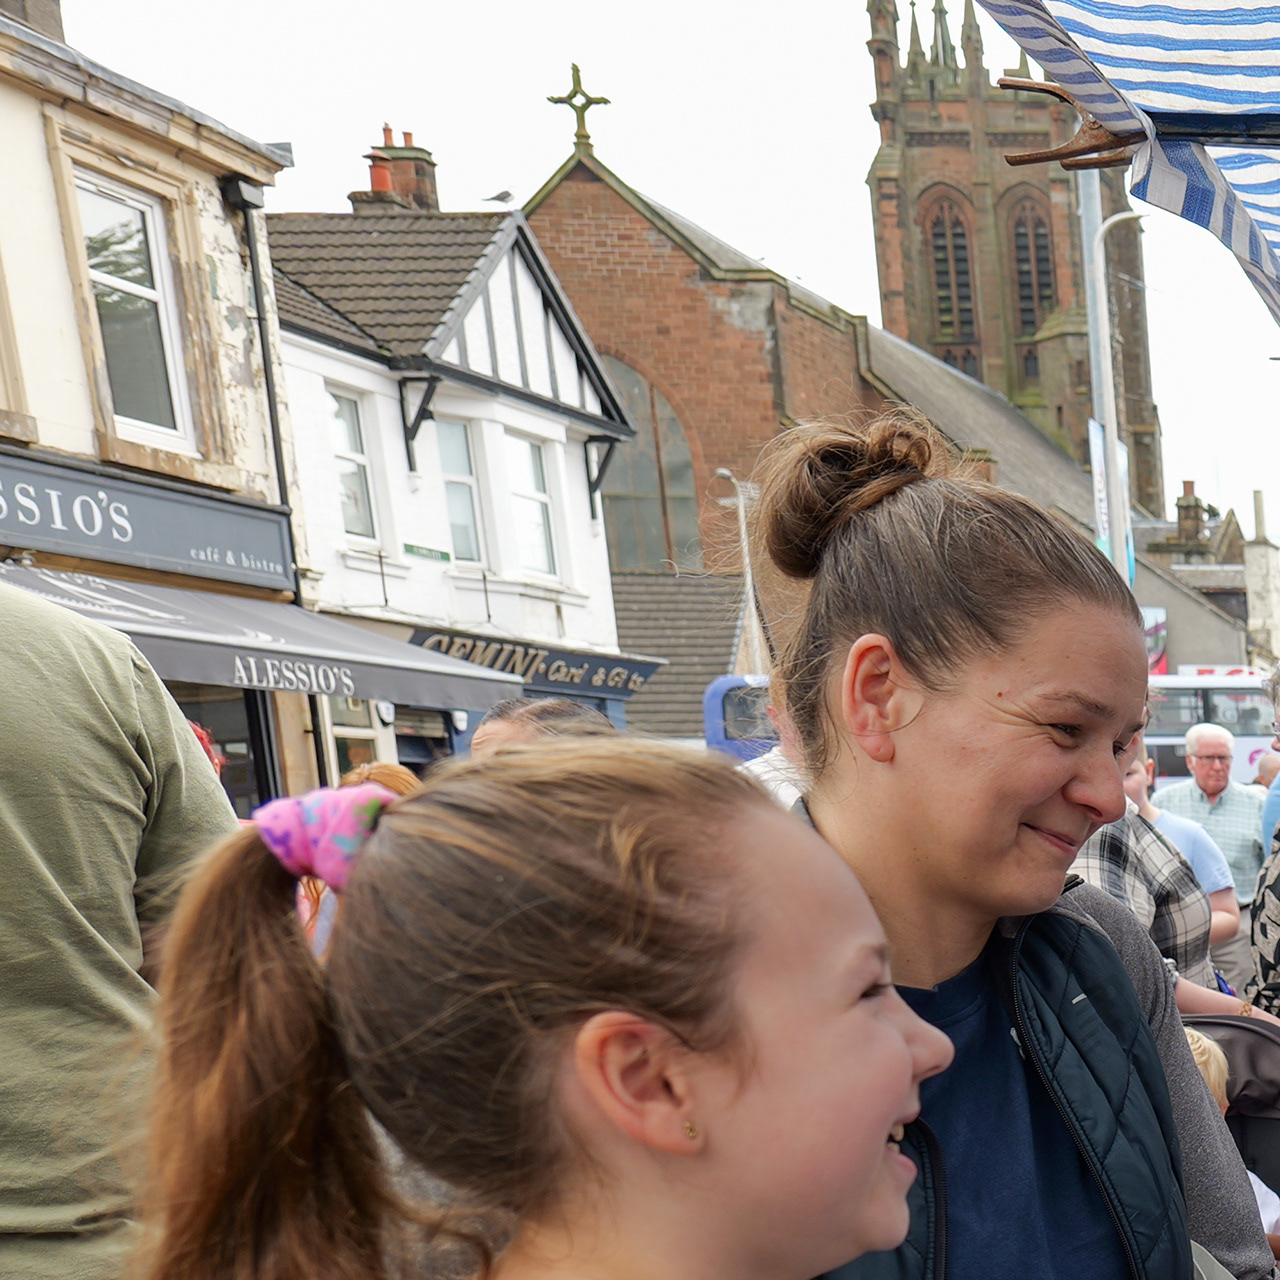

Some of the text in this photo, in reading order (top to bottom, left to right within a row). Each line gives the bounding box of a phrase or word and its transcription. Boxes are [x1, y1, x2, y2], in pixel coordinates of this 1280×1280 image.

[225, 549, 237, 566] &
[240, 552, 284, 575] bistro
[233, 654, 356, 697] ALESSIO'S
